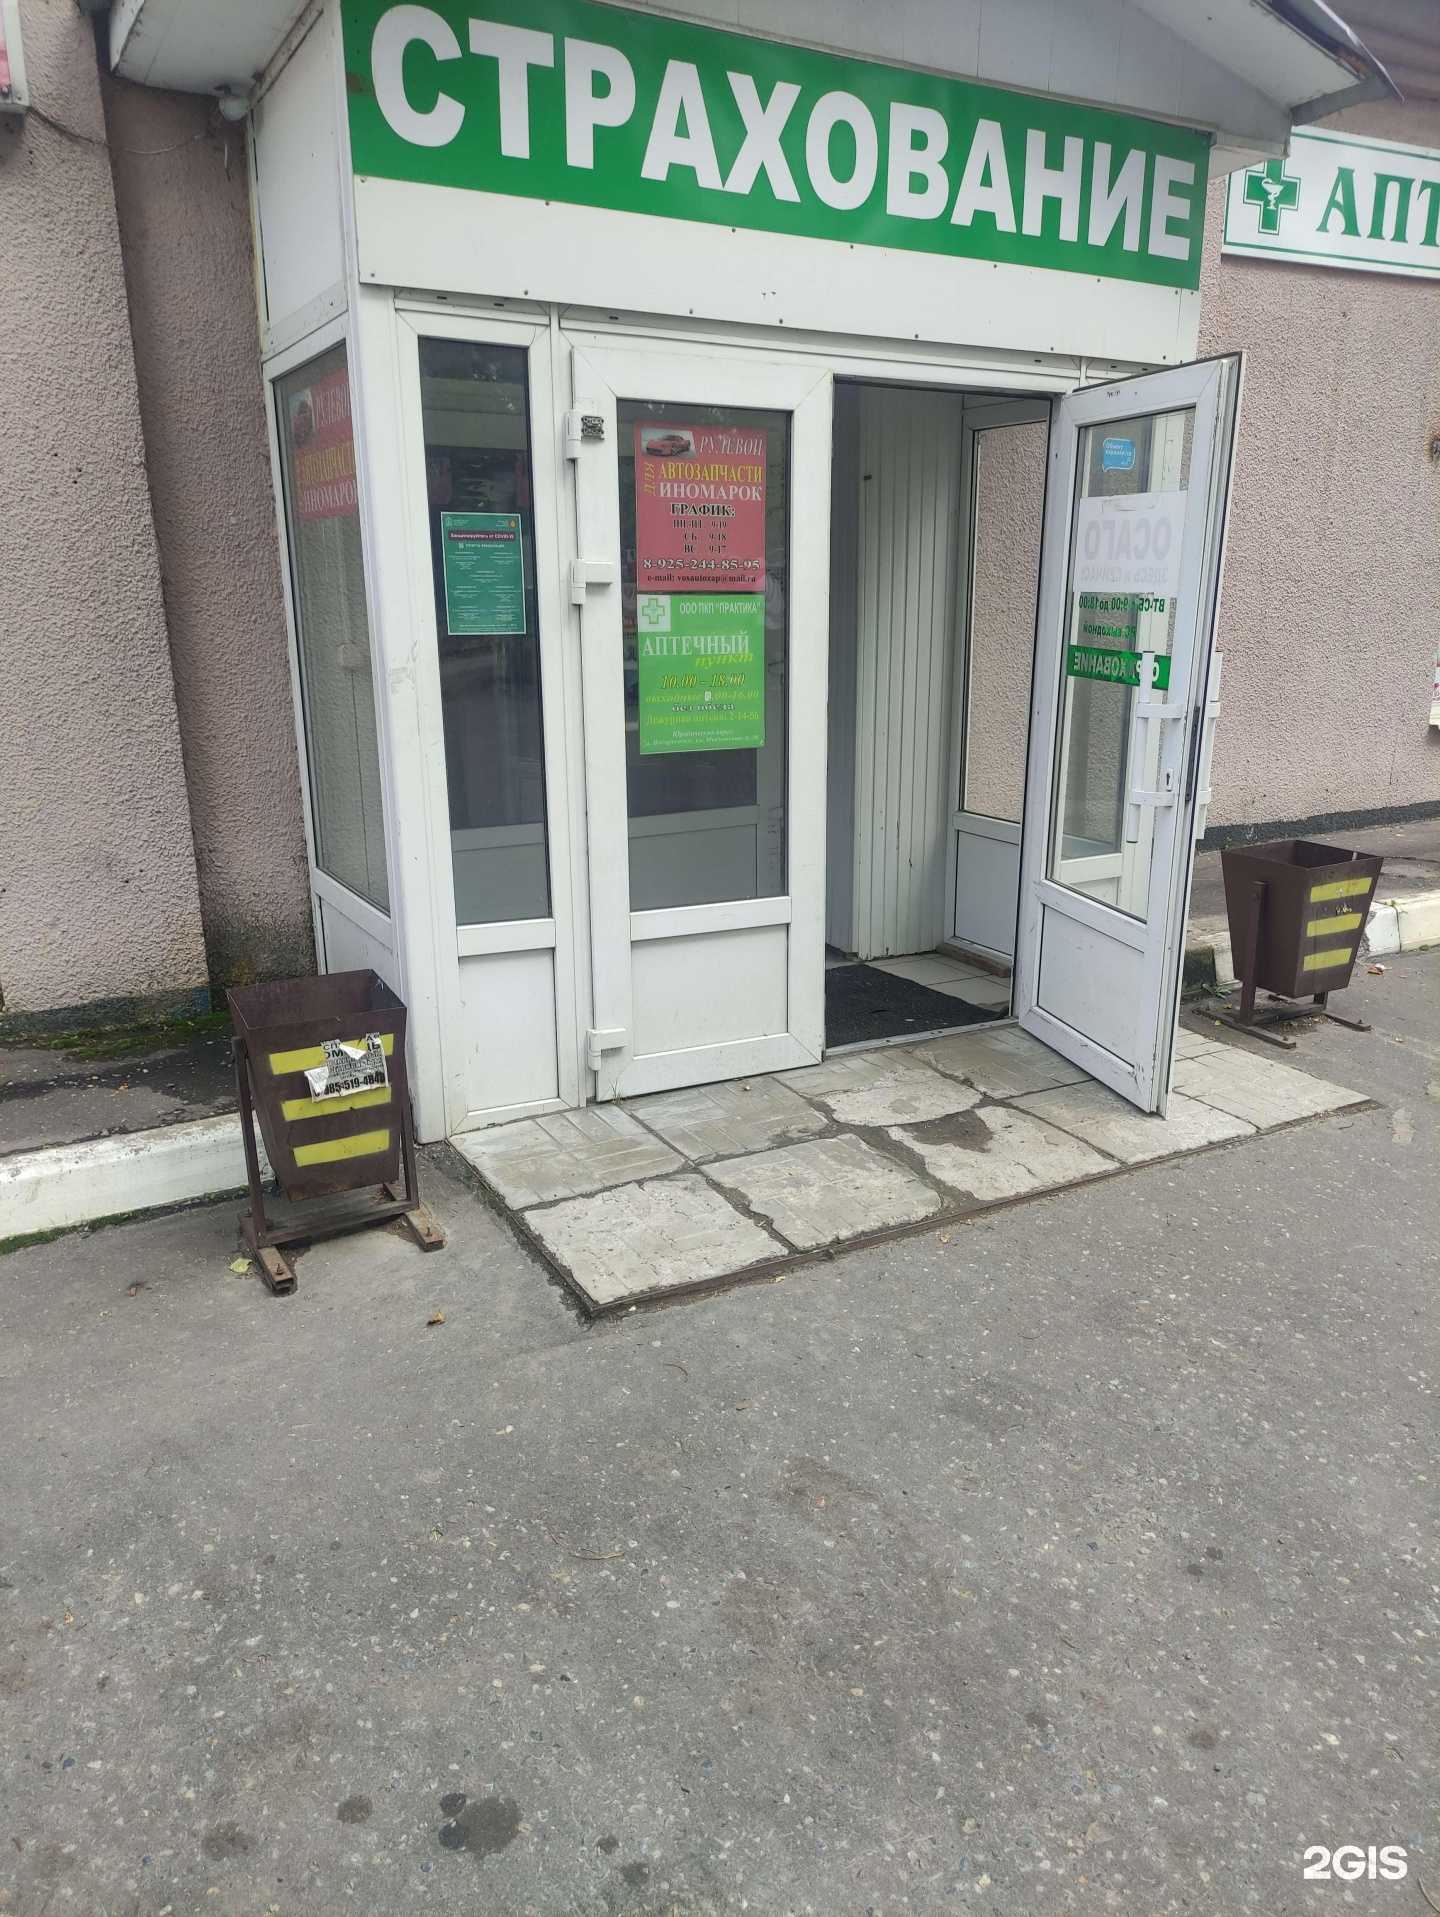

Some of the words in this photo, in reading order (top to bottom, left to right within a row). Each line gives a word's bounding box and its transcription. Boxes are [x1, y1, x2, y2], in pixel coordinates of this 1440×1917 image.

[371, 5, 1196, 260] СТРАХОВАНИЕ
[660, 462, 762, 483] АВТОЗАПЧАСТИ
[660, 482, 763, 501] ИНОМАРОК
[671, 503, 736, 518] ГРАФИК:
[643, 558, 761, 570] 8-925-244-85-95
[680, 602, 697, 615] ООО
[641, 630, 750, 656] АПТЕЧНЫЙ
